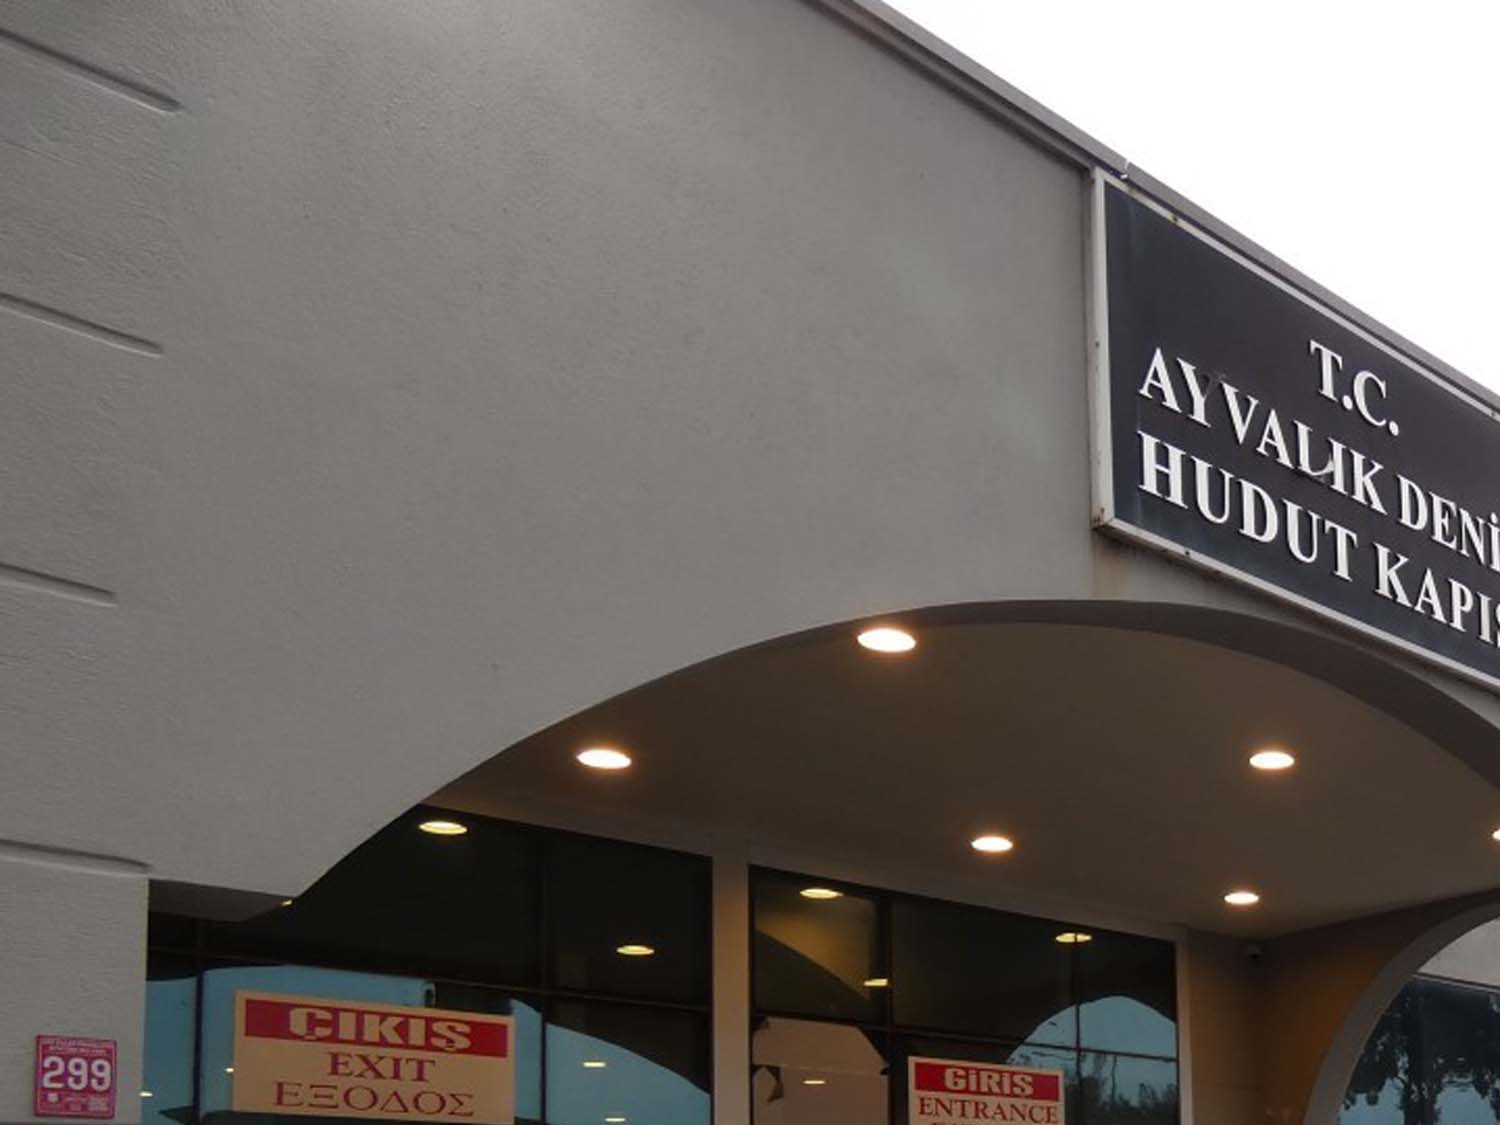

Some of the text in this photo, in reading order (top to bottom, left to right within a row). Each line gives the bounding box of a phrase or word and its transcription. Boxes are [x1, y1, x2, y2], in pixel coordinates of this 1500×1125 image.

[1310, 339, 1400, 437] T.C.
[1138, 346, 1388, 516] AYVALIK
[1137, 430, 1359, 583] HUDUT
[42, 1055, 112, 1093] 299
[326, 1052, 436, 1083] EXIT
[918, 1096, 1059, 1125] ENTRANCE
